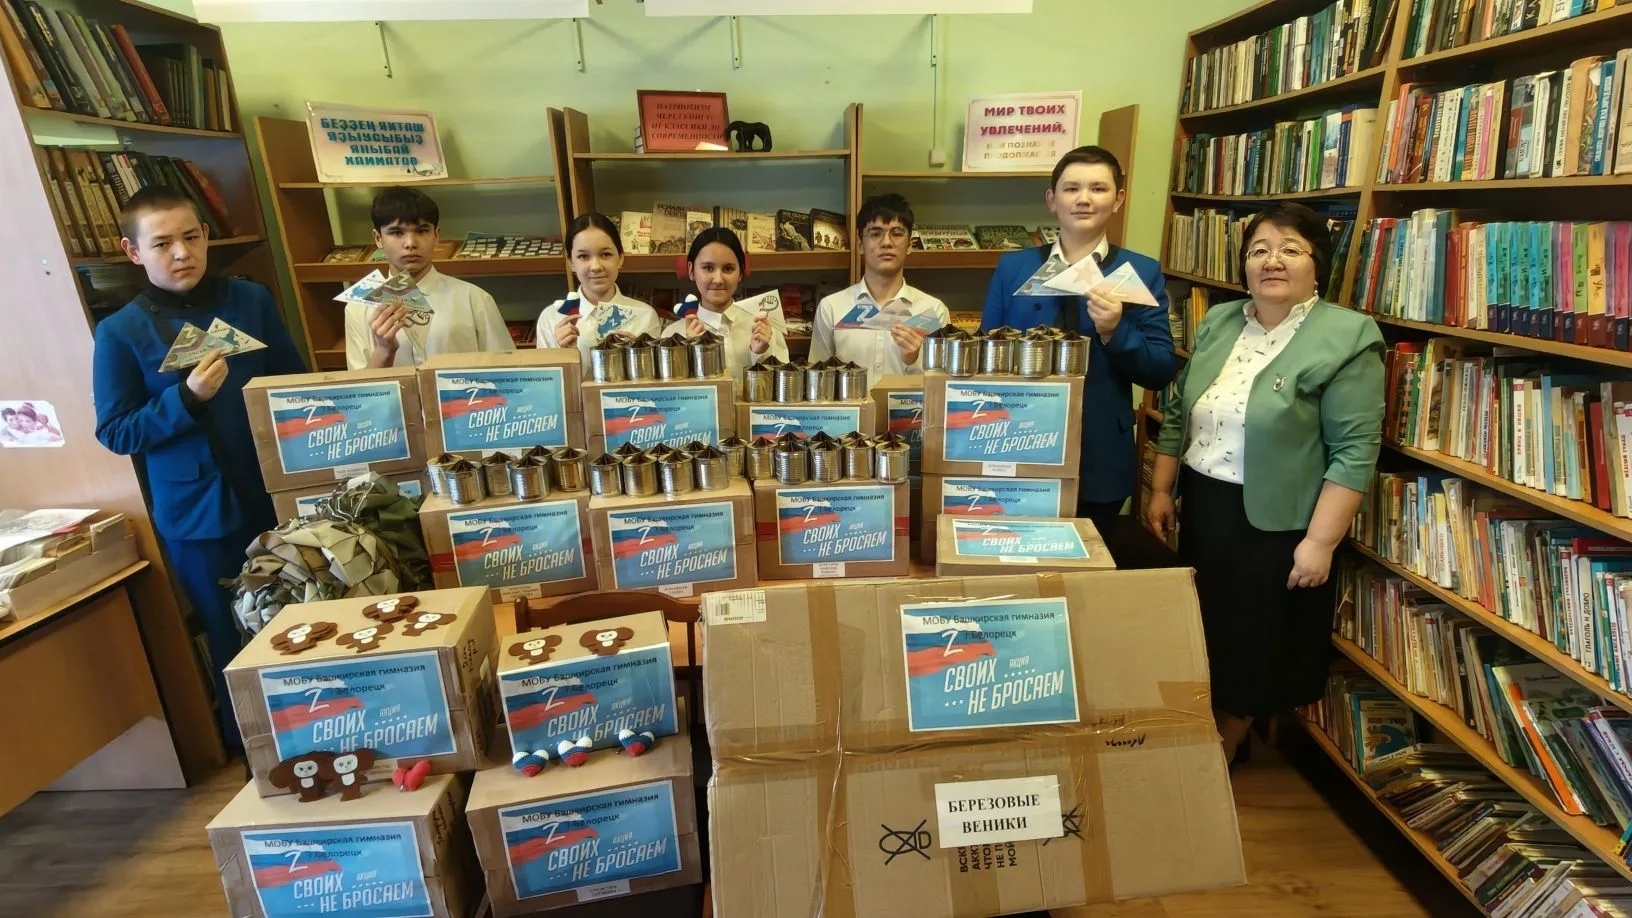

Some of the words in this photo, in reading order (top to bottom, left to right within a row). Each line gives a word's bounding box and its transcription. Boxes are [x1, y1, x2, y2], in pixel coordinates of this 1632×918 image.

[984, 107, 1015, 117] МИР
[1018, 105, 1065, 116] ТВОИХ
[980, 122, 1066, 136] УВЛЕЧЕНИЙ,
[468, 406, 508, 429] СВОИХ
[486, 425, 500, 442] НЕ
[503, 414, 559, 439] БРОСАЕМ
[308, 423, 348, 448] СВОИХ
[630, 423, 667, 445] СВОИХ
[969, 420, 1010, 441] СВОИХ
[327, 441, 342, 460] НЕ
[345, 428, 398, 456] БРОСАЕМ
[984, 438, 999, 455] НЕ
[1001, 432, 1059, 453] БРОСАЕМ
[464, 519, 487, 527] МОБУ
[533, 510, 567, 518] гимназия
[624, 517, 645, 525] МОБУ
[691, 511, 724, 519] гимназия
[803, 523, 841, 545] СВОИХ
[818, 541, 832, 558] НЕ
[834, 530, 887, 555] БРОСАЕМ
[982, 536, 1022, 547] СВОИХ
[484, 544, 524, 569] СВОИХ
[640, 543, 679, 567] СВОИХ
[1000, 545, 1014, 553] НЕ
[1018, 542, 1075, 553] БРОСАЕМ
[503, 563, 517, 580] НЕ
[520, 548, 575, 577] БРОСАЕМ
[657, 562, 672, 580] НЕ
[674, 548, 728, 575] БРОСАЕМ
[1583, 592, 1591, 617] ДОБРО
[922, 616, 951, 625] МОБУ
[953, 614, 1009, 625] Башкирская
[1011, 612, 1055, 622] гимназия
[1583, 623, 1592, 653] ГЛАГОЛЬ
[521, 676, 551, 688] МОБУ
[554, 665, 611, 682] Башкирская
[613, 656, 658, 671] гимназия
[1009, 655, 1030, 668] АКЦИЯ
[283, 676, 314, 688] МОБУ
[316, 670, 377, 684] Башкирская
[378, 664, 426, 677] гимназия
[943, 658, 997, 693] СВОИХ
[967, 686, 986, 715] НЕ
[991, 669, 1065, 710] БРОСАЕМ
[379, 704, 401, 718] АКЦИЯ
[547, 704, 599, 738] СВОИХ
[594, 704, 665, 743] БРОСАЕМ
[313, 709, 366, 744] СВОИХ
[364, 713, 438, 750] БРОСАЕМ
[522, 812, 552, 824] МОБУ
[554, 800, 613, 818] Башкирская
[614, 793, 659, 808] гимназия
[948, 793, 1041, 813] БЕРЕЗОВЫЕ
[962, 816, 1028, 834] ВЕНИКИ
[264, 840, 294, 849] МОБУ
[296, 836, 353, 847] Башкирская
[355, 833, 402, 843] гимназия
[548, 839, 600, 871] СВОИХ
[572, 860, 591, 882] НЕ
[595, 837, 667, 875] БРОСАЕМ
[996, 854, 1004, 869] НЕ
[293, 872, 344, 900] СВОИХ
[320, 895, 340, 914] НЕ
[342, 881, 414, 911] БРОСАЕМ
